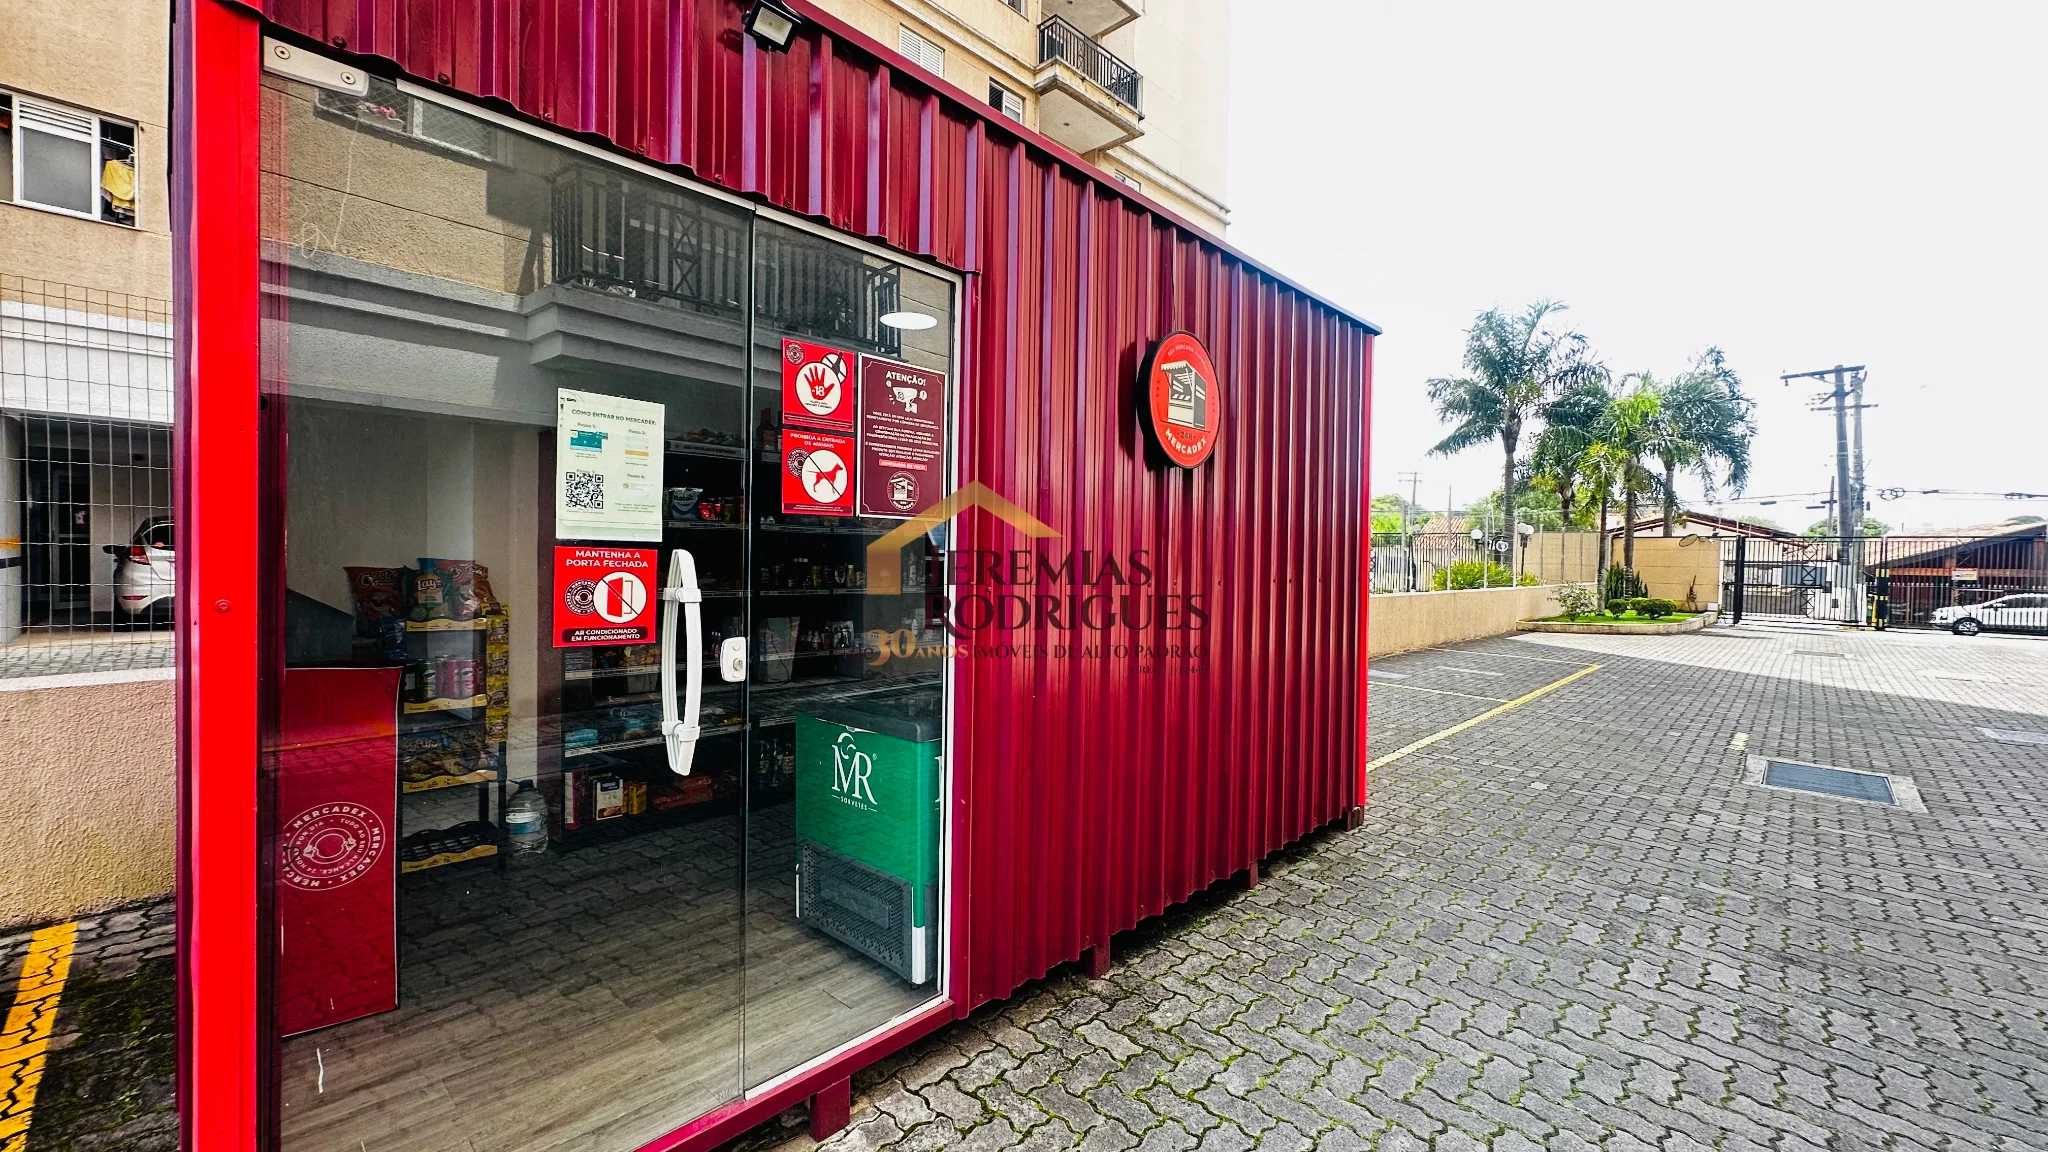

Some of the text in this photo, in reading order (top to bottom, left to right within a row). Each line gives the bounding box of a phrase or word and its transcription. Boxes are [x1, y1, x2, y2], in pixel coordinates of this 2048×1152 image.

[886, 371, 926, 386] ATENÇÃO!
[812, 385, 825, 397] -18
[571, 409, 591, 417] COMO
[592, 411, 615, 419] ENTRAR
[625, 416, 657, 426] MERCADEX:
[790, 432, 816, 441] PROIBIDA
[1165, 427, 1207, 455] MERCADEX
[575, 550, 632, 559] MANTENHA
[566, 559, 649, 568] PORTA FECHADA
[583, 633, 640, 641] FUNCIONAMENTO
[586, 628, 637, 636] CONDICIONADO
[831, 744, 878, 805] MR
[840, 796, 868, 811] SORVETES
[292, 805, 368, 829] MERCADEX
[340, 818, 359, 829] TUDO
[295, 831, 309, 845] POR
[309, 820, 325, 831] DIA
[357, 829, 366, 839] AO
[339, 826, 381, 882] MERCADEX
[357, 840, 366, 854] SEU
